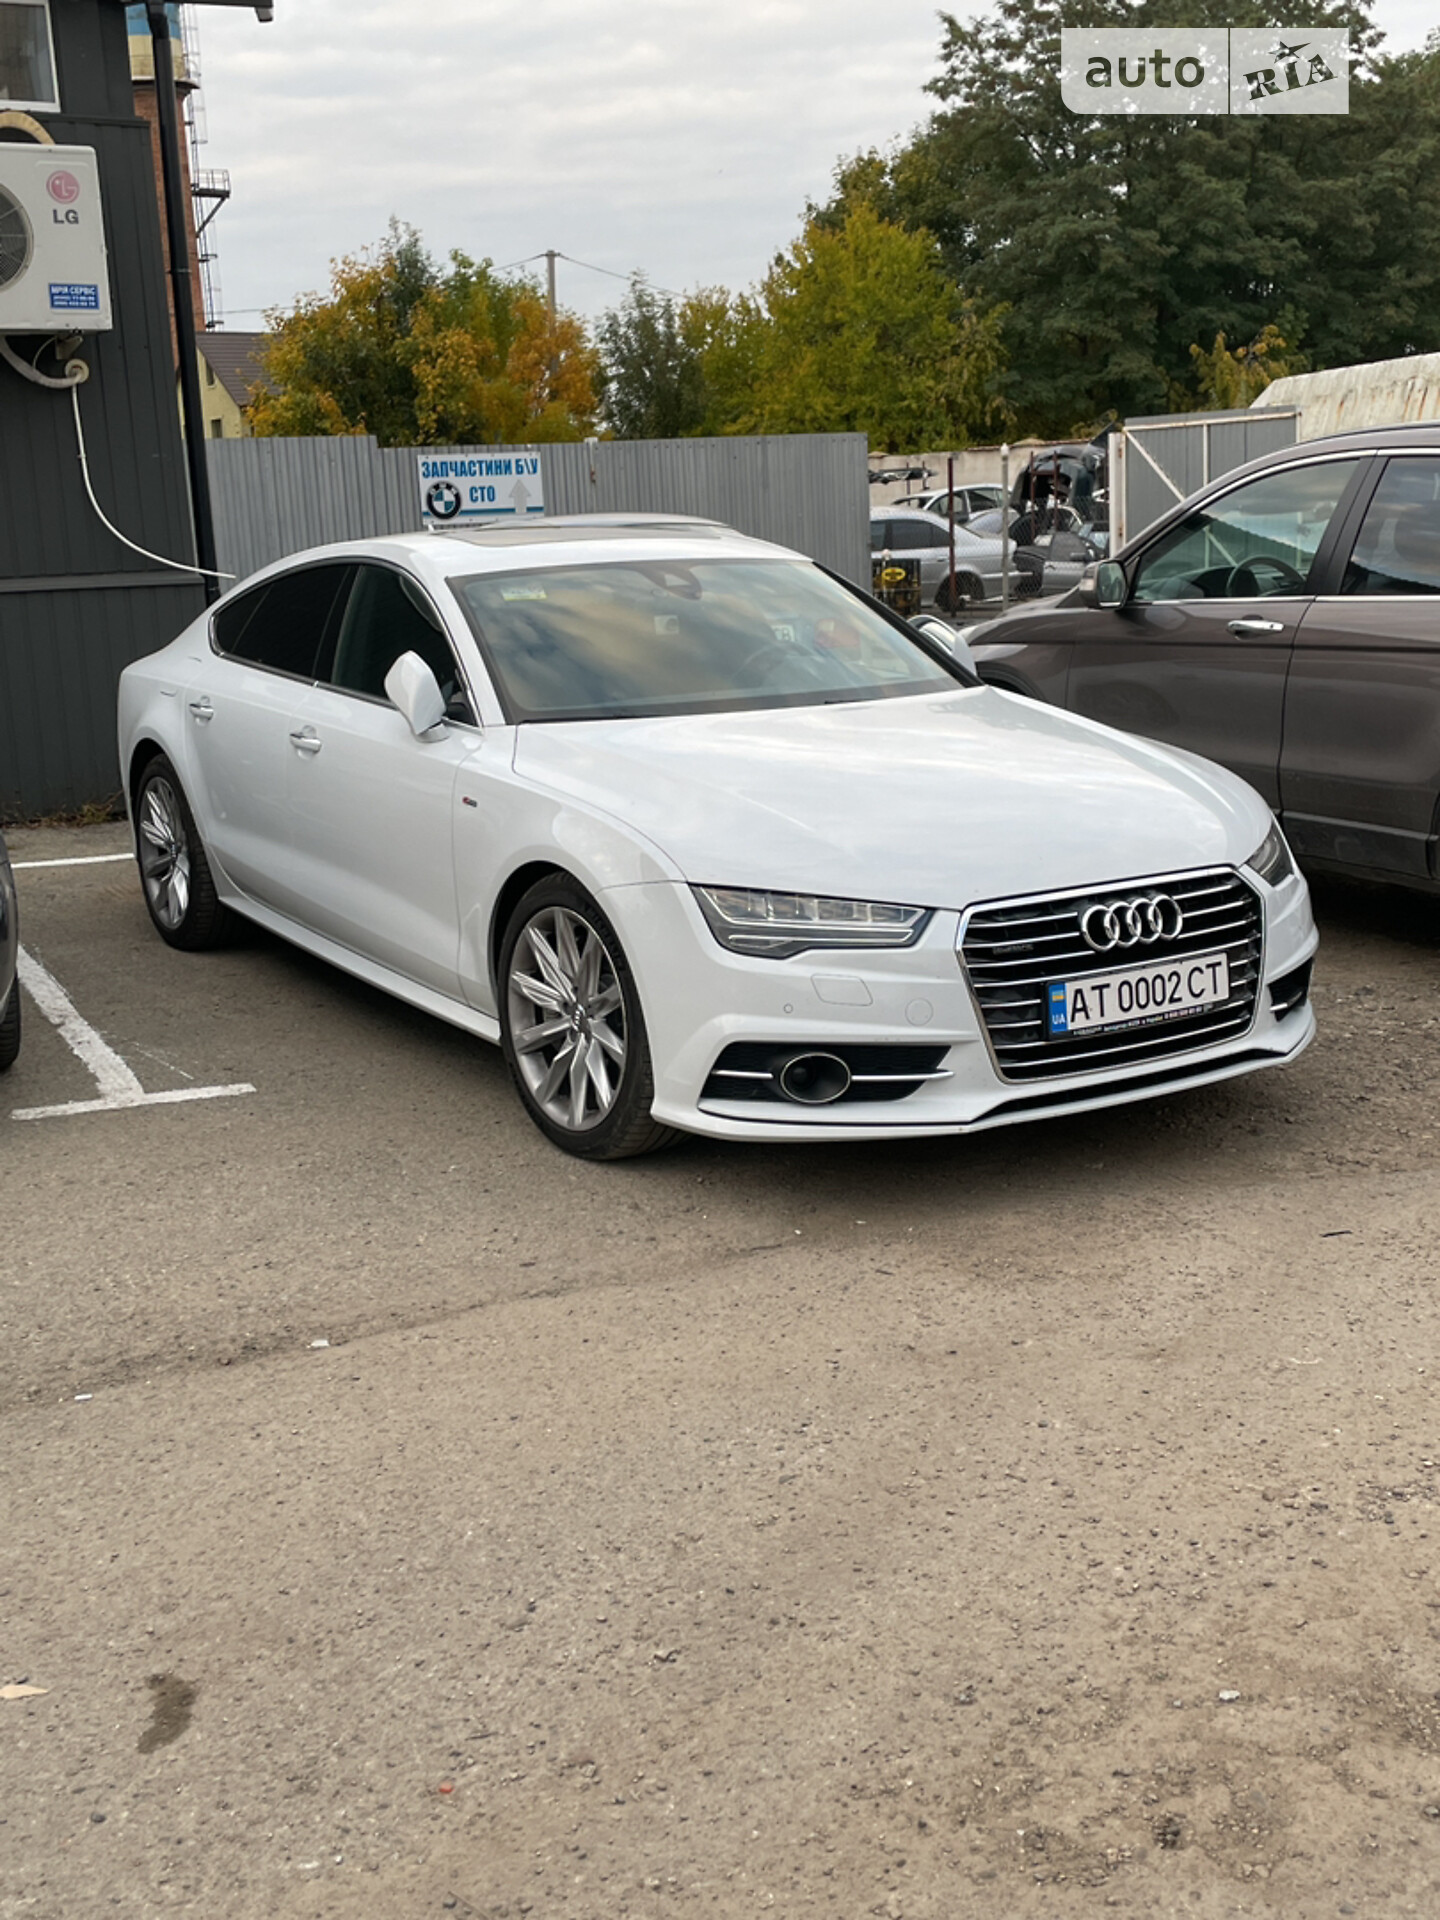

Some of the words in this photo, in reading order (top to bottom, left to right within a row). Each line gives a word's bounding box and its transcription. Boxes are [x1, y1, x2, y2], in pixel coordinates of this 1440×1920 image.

[53, 209, 79, 224] LG
[422, 459, 512, 478] ЗАПЧАСТИНИ
[515, 458, 538, 475] Б\У
[469, 485, 495, 502] СТО
[1071, 983, 1111, 1023] AT
[1118, 971, 1182, 1012] 0002
[1188, 961, 1222, 998] CT
[1052, 1014, 1066, 1025] UA
